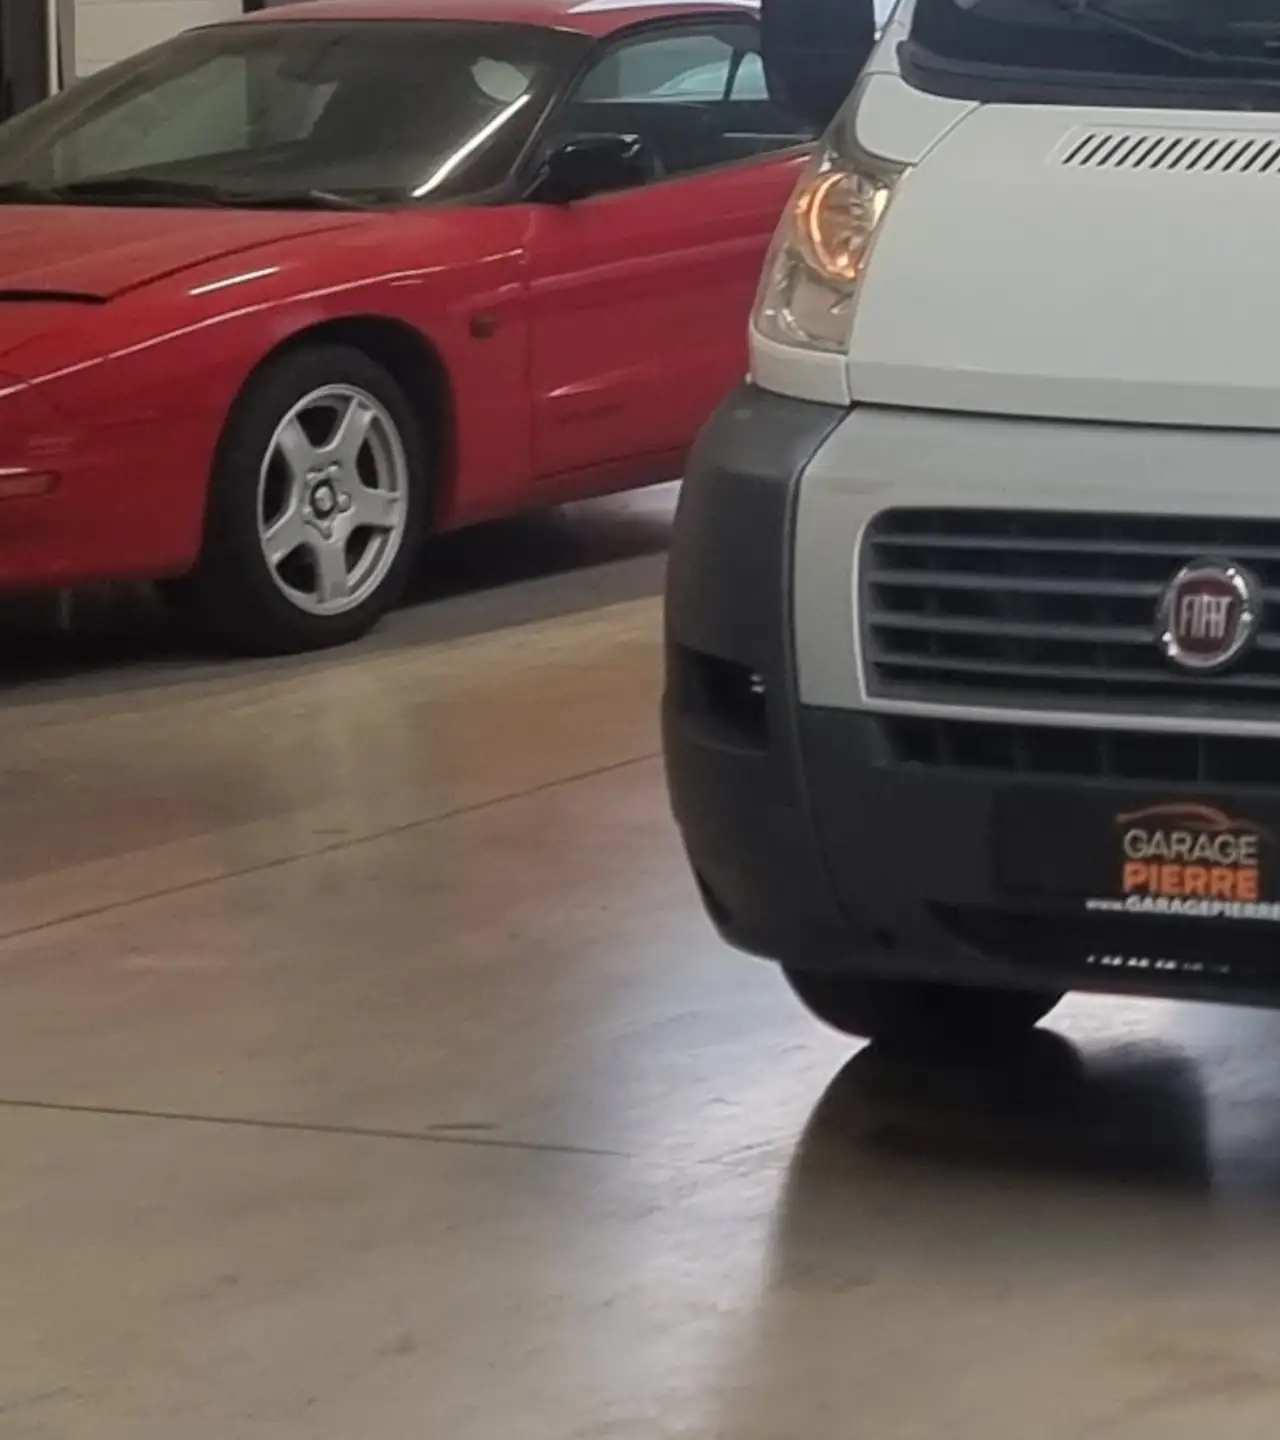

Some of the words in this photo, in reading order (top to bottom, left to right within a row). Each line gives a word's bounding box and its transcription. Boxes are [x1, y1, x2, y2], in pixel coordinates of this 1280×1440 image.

[1178, 593, 1233, 639] FIAT
[1122, 828, 1259, 866] GARAGE
[1122, 860, 1260, 902] PIERRE
